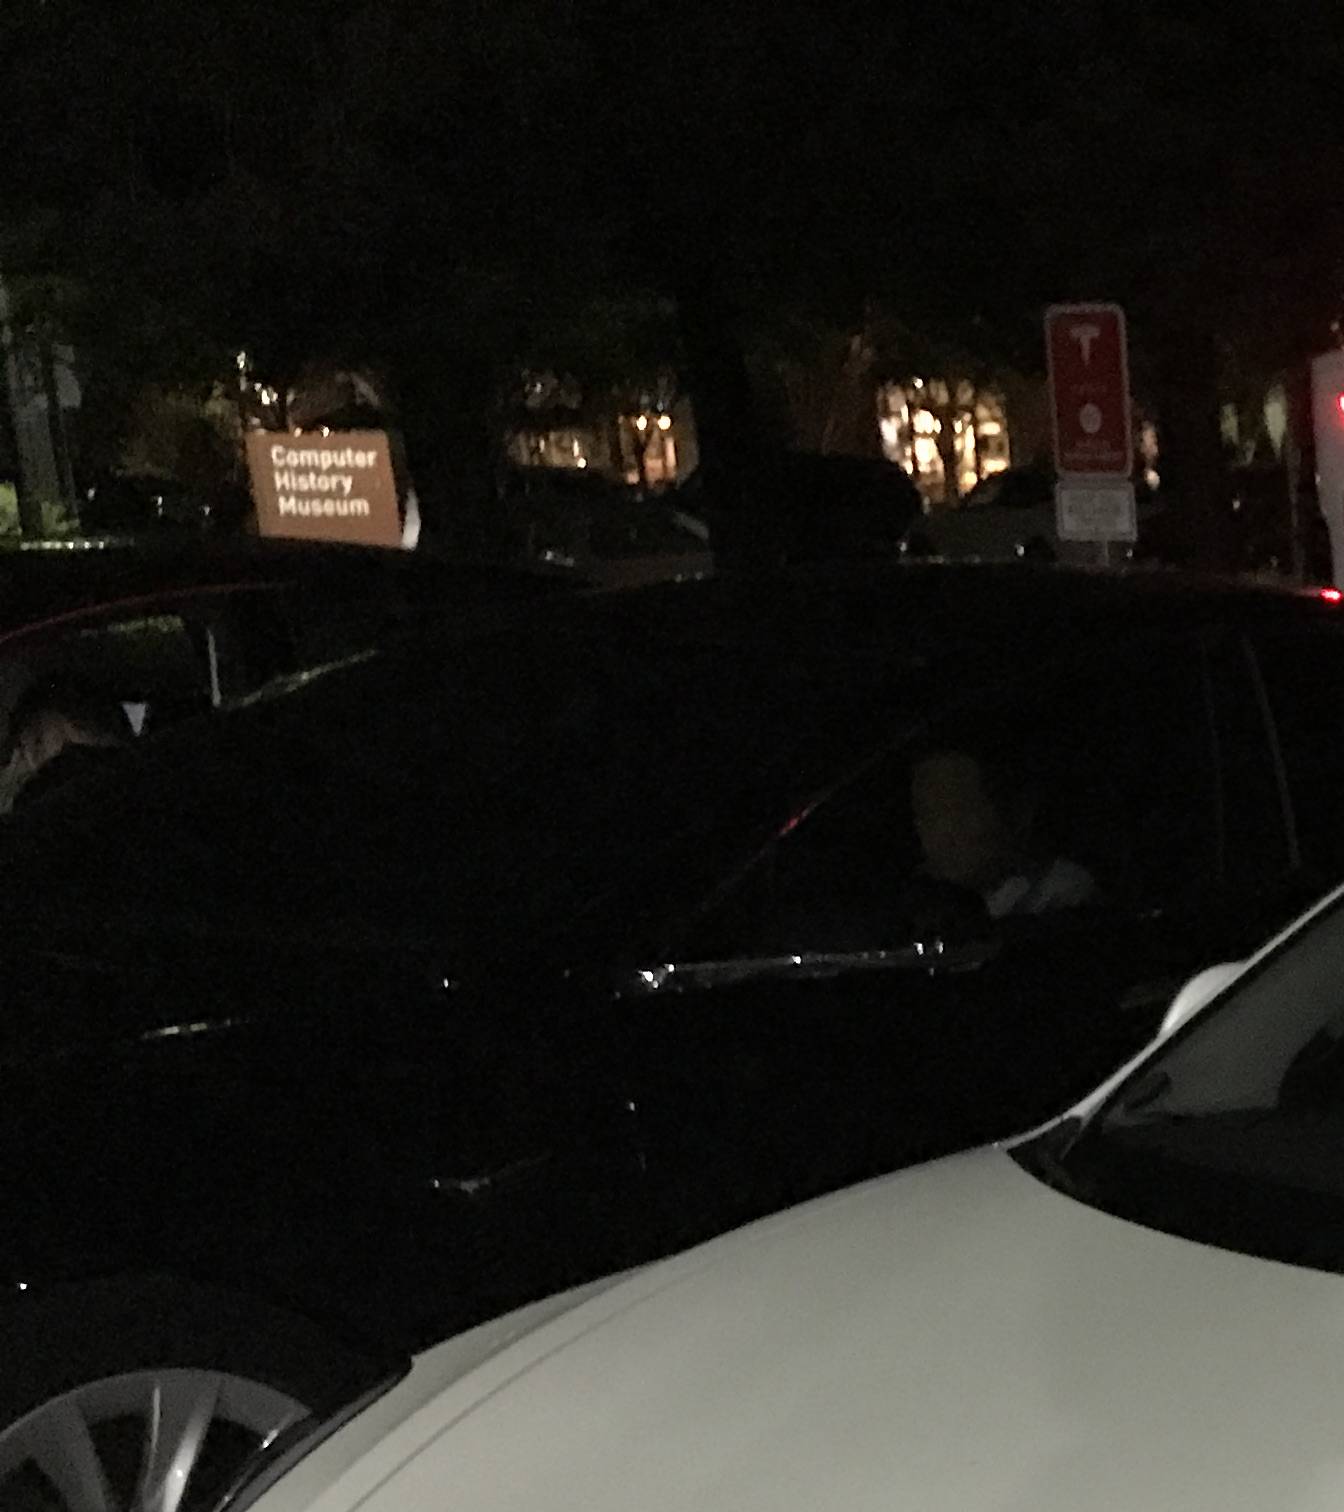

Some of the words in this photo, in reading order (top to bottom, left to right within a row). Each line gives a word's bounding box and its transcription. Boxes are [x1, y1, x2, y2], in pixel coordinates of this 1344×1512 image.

[270, 444, 377, 471] Computer
[274, 470, 353, 497] History
[278, 495, 370, 517] Museum
